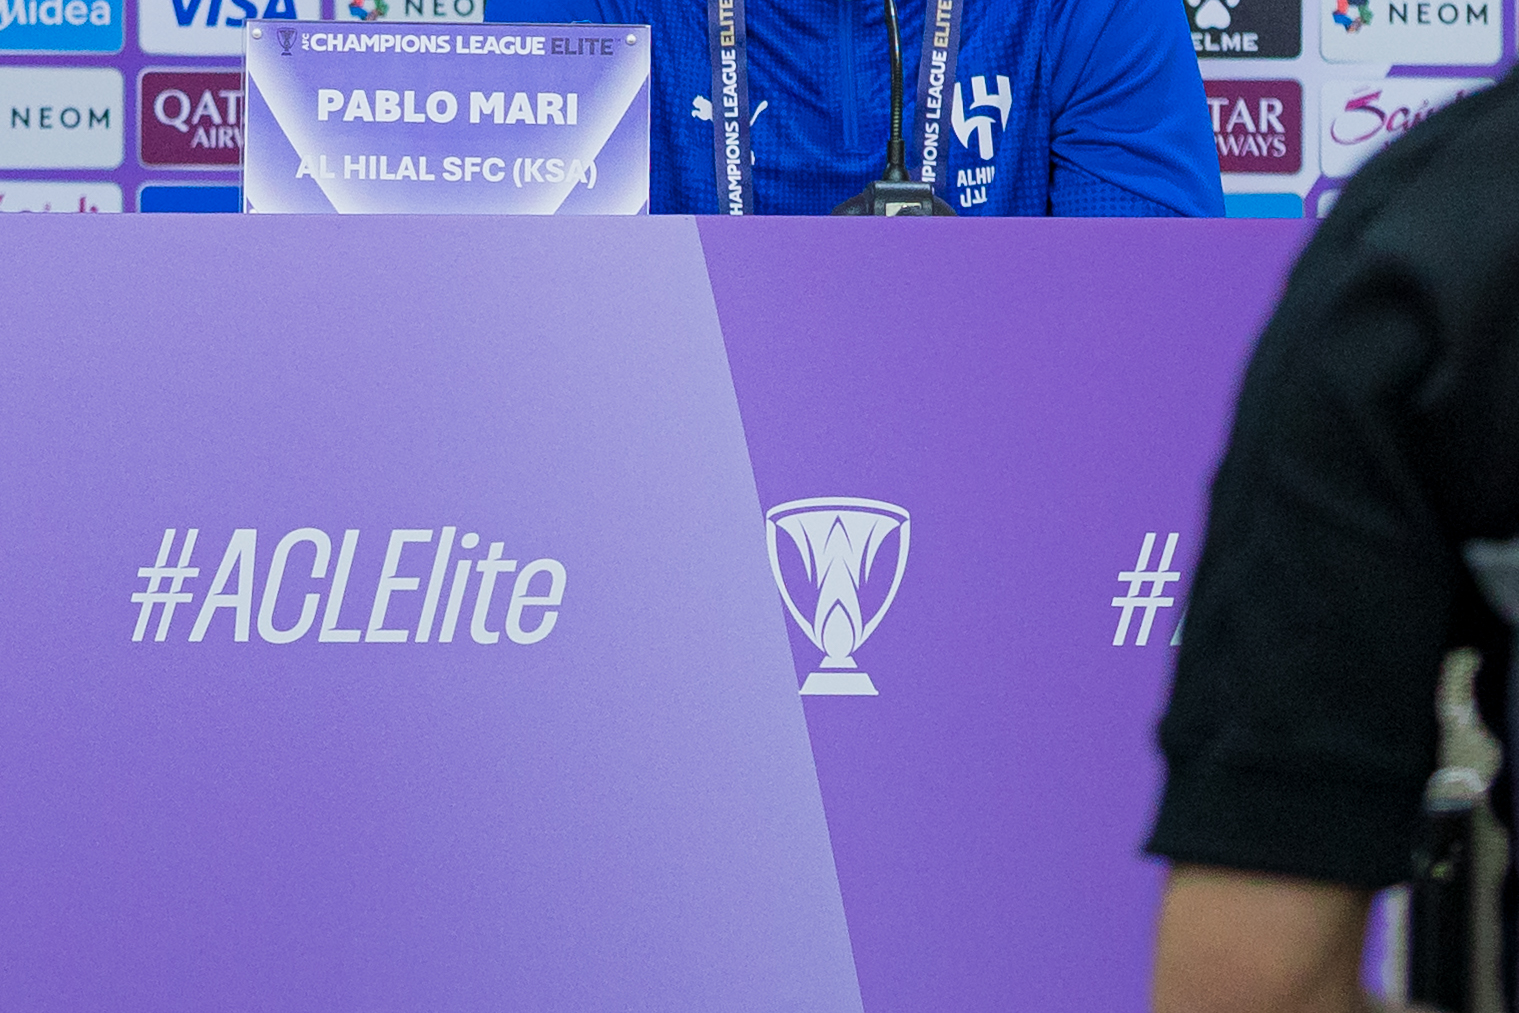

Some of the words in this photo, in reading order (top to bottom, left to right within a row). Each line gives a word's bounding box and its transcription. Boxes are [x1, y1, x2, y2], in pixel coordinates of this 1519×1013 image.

[1388, 2, 1489, 25] NEOM
[310, 33, 450, 54] CHAMPIONS
[456, 35, 546, 55] LEAGUE
[721, 49, 739, 119] LEAGUE
[926, 49, 947, 120] LEAGUE
[10, 106, 111, 130] NEOM
[317, 89, 458, 124] PABLO
[469, 92, 578, 125] MARI
[921, 121, 940, 183] PIONS
[1215, 134, 1287, 158] WAYS
[295, 155, 336, 179] AL
[343, 155, 436, 181] HILAL
[442, 157, 506, 182] SFC
[512, 158, 597, 189] (KSA)
[130, 526, 568, 645] #ACLElite
